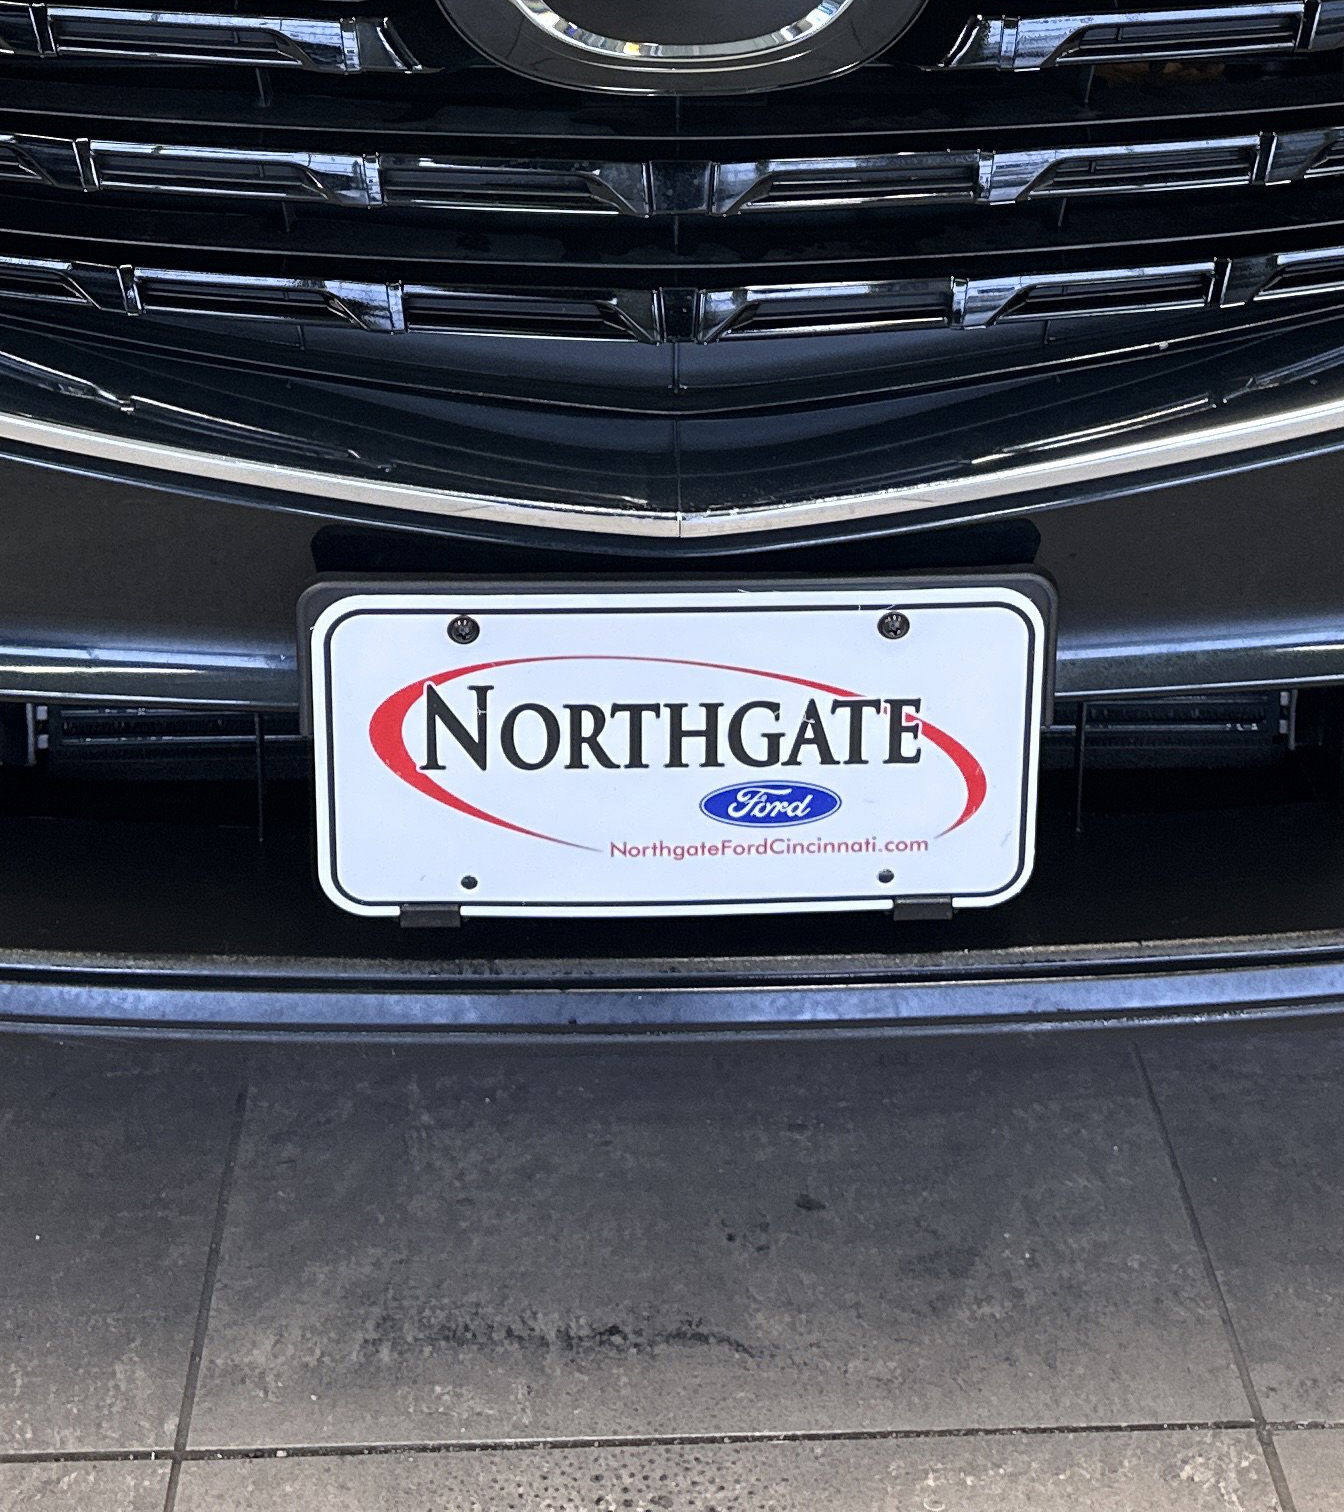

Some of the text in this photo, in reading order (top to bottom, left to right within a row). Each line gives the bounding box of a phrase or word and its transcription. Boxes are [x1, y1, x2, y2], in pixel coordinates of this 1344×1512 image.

[419, 683, 922, 771] NORTHGATE
[727, 787, 811, 819] Ford
[609, 836, 929, 861] NorthgateFordCincinnati.com
